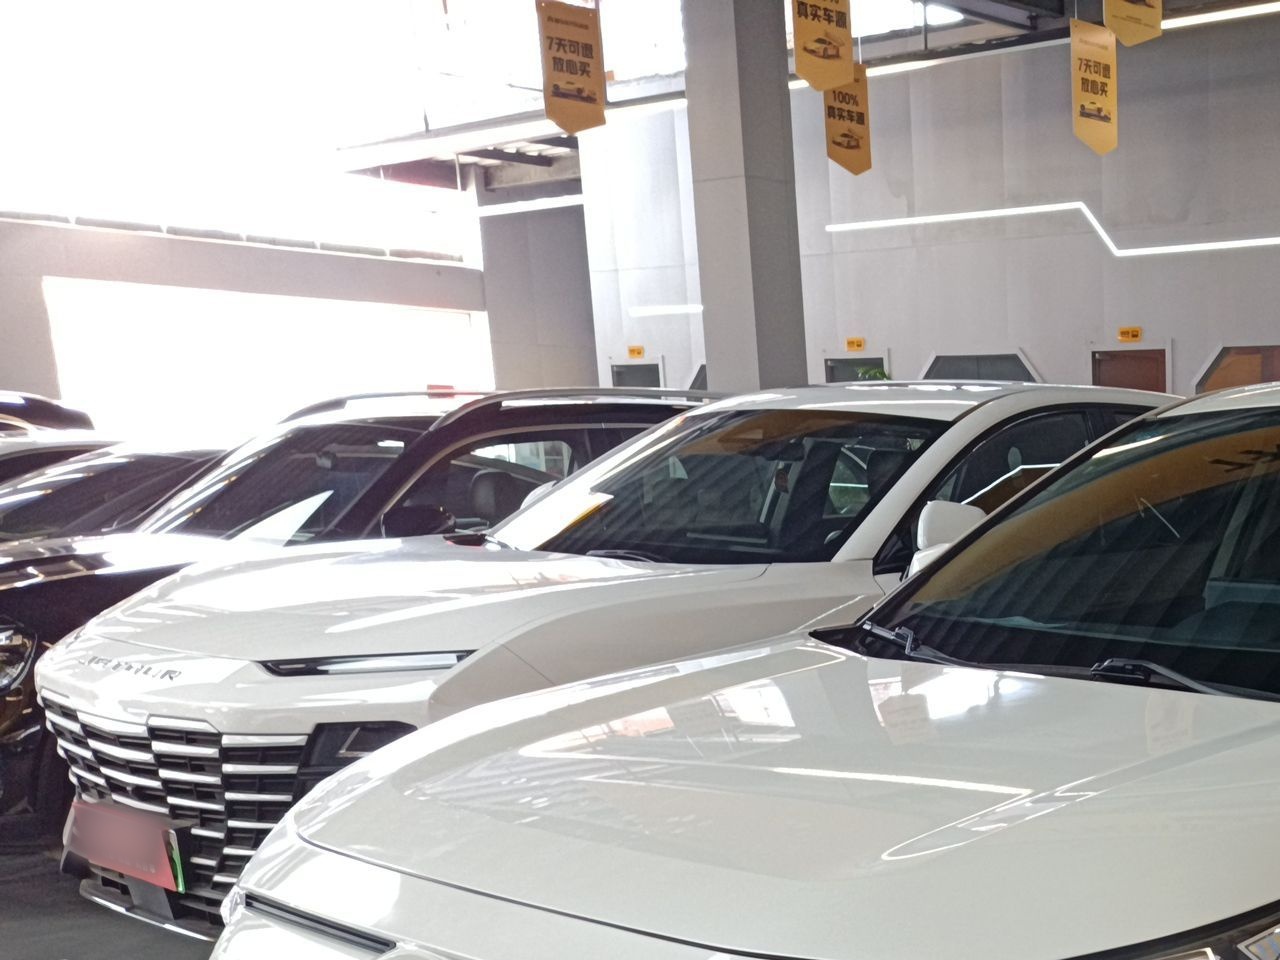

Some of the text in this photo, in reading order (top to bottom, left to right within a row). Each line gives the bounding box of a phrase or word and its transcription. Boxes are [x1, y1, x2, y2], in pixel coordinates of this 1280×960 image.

[797, 0, 847, 29] 真实车源
[546, 36, 594, 59] 7天可退
[552, 56, 591, 78] 放心买
[1078, 57, 1111, 79] 7天可退
[1081, 77, 1108, 97] 放心买
[832, 90, 859, 107] 100%
[827, 105, 865, 125] 真实车源
